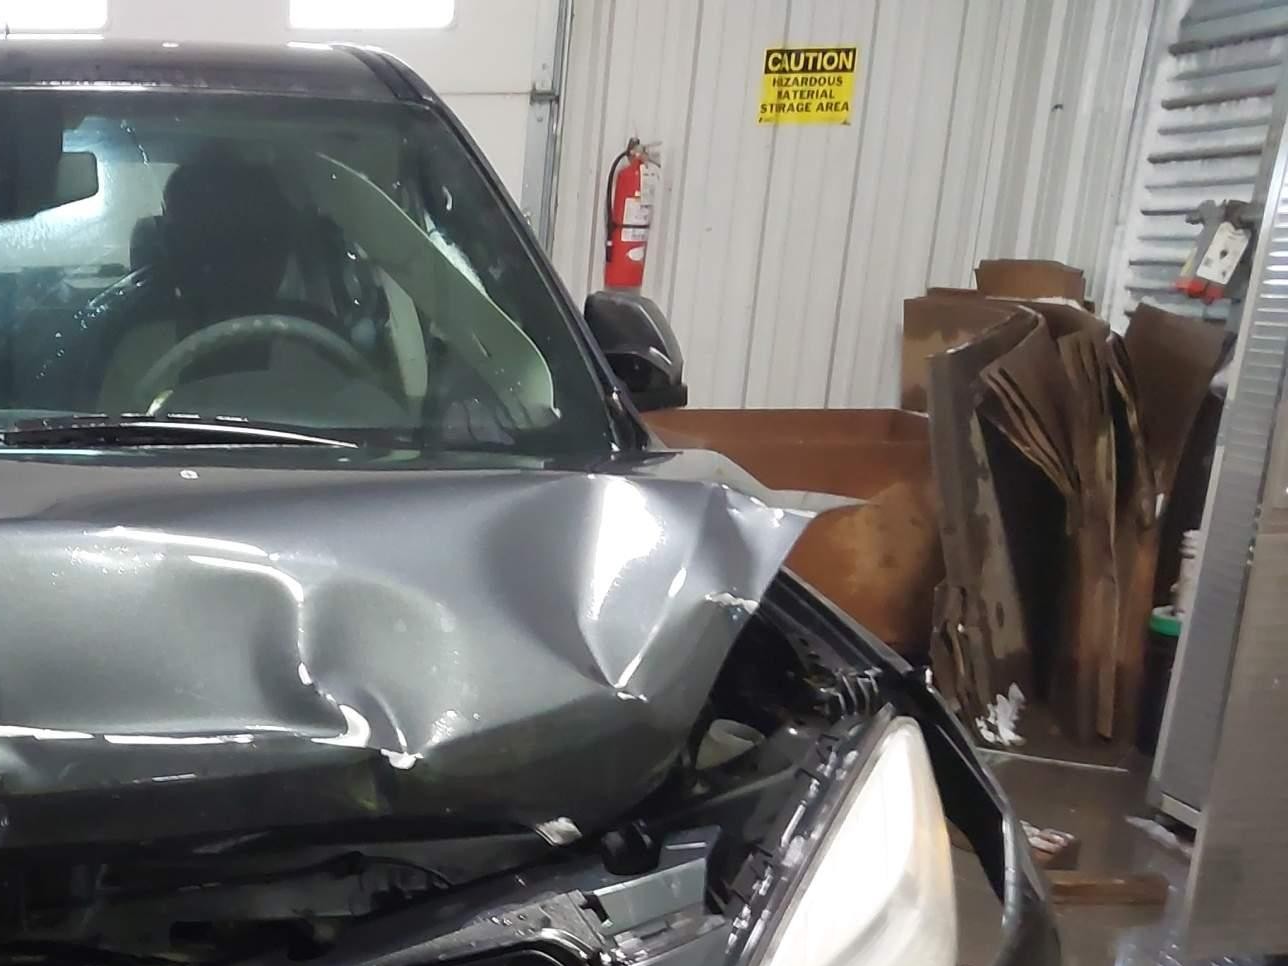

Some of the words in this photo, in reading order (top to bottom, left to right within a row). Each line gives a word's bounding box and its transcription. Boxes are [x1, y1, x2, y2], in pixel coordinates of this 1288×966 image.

[767, 50, 854, 72] CAUTION
[772, 76, 844, 88] HAZARDOUS
[776, 89, 836, 101] MATERIAL
[760, 102, 812, 114] STORAGE
[815, 101, 850, 113] AREA
